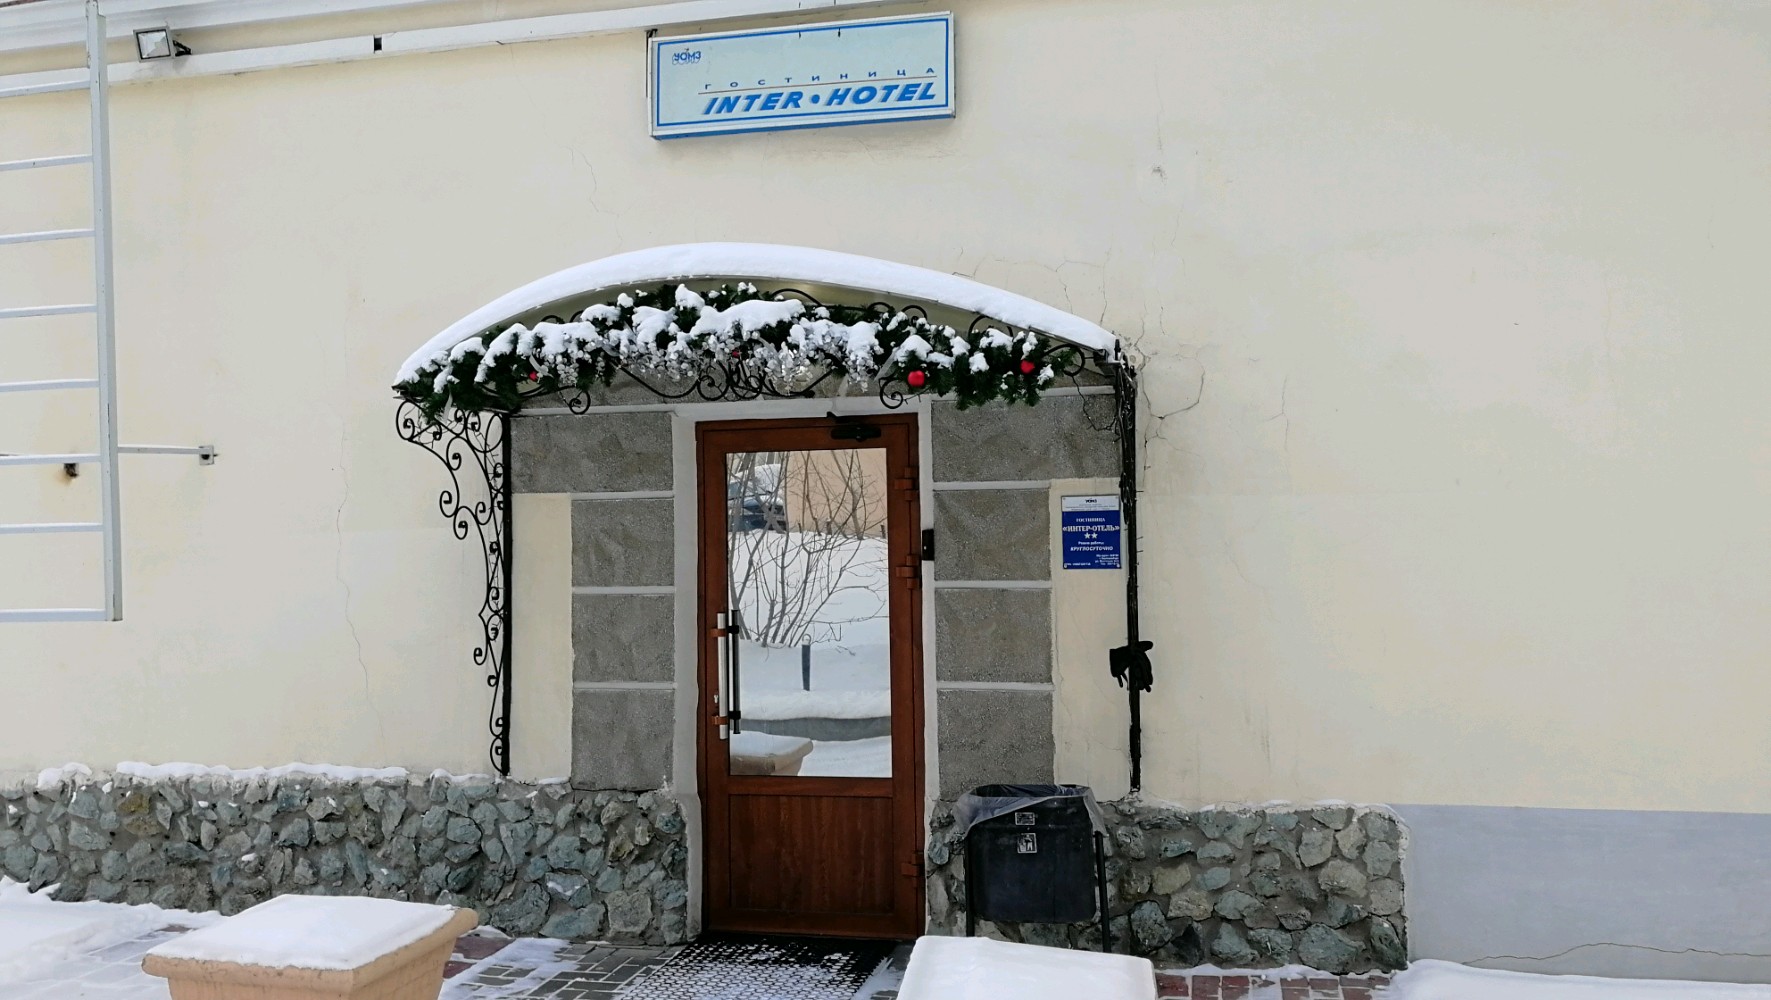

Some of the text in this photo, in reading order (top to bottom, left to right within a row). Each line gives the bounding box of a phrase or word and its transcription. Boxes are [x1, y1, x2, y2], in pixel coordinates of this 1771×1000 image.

[673, 50, 702, 63] УОМЗ
[704, 67, 935, 90] ГОСТИНИЦА
[703, 82, 936, 115] INTER HOTEL
